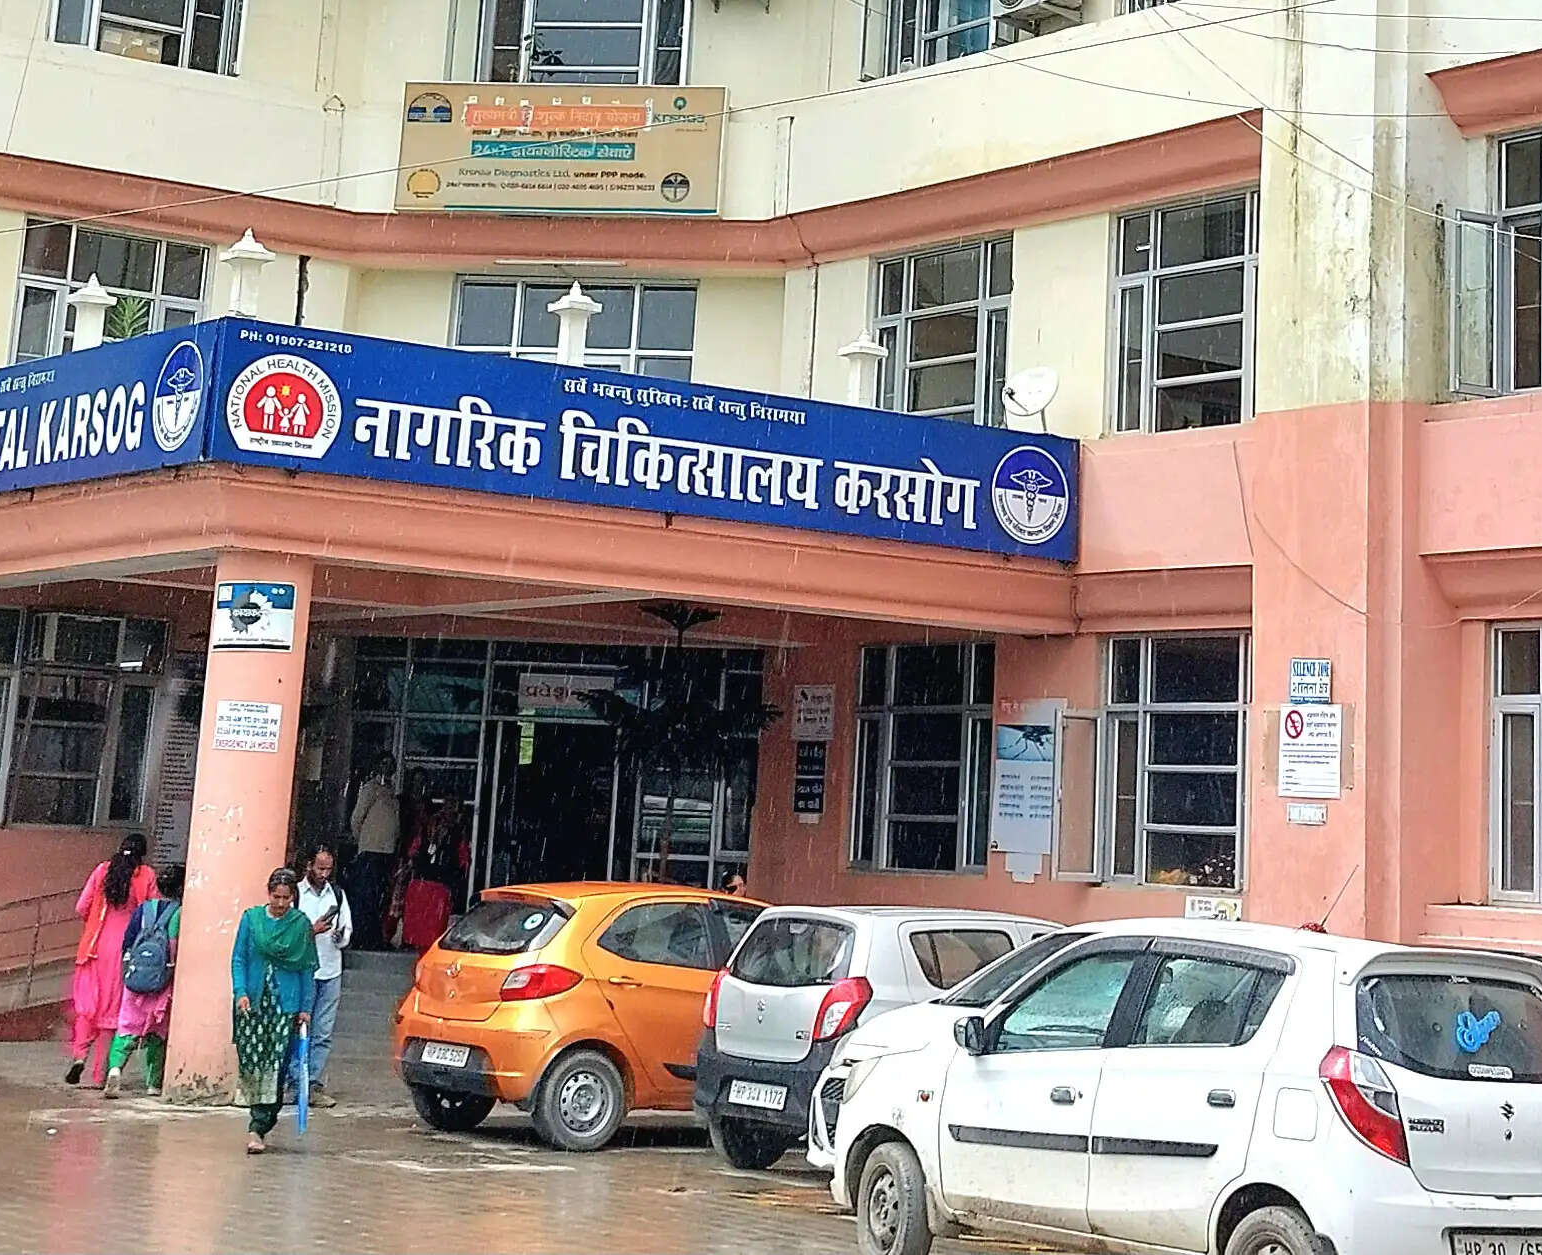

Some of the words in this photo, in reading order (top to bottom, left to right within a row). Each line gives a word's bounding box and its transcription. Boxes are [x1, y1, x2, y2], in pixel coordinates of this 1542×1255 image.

[231, 365, 265, 429] NATIONAL
[267, 359, 319, 380] HEALTH
[317, 379, 337, 439] MISSION
[563, 377, 587, 394] सर्वे
[35, 380, 146, 465] KARSOG
[354, 395, 546, 474] नागरिक
[558, 409, 824, 509] चिकित्सालय
[834, 457, 980, 530] करसोग
[1293, 661, 1316, 676] SILENCE
[1318, 662, 1329, 677] ZONE
[1465, 1241, 1482, 1255] HP
